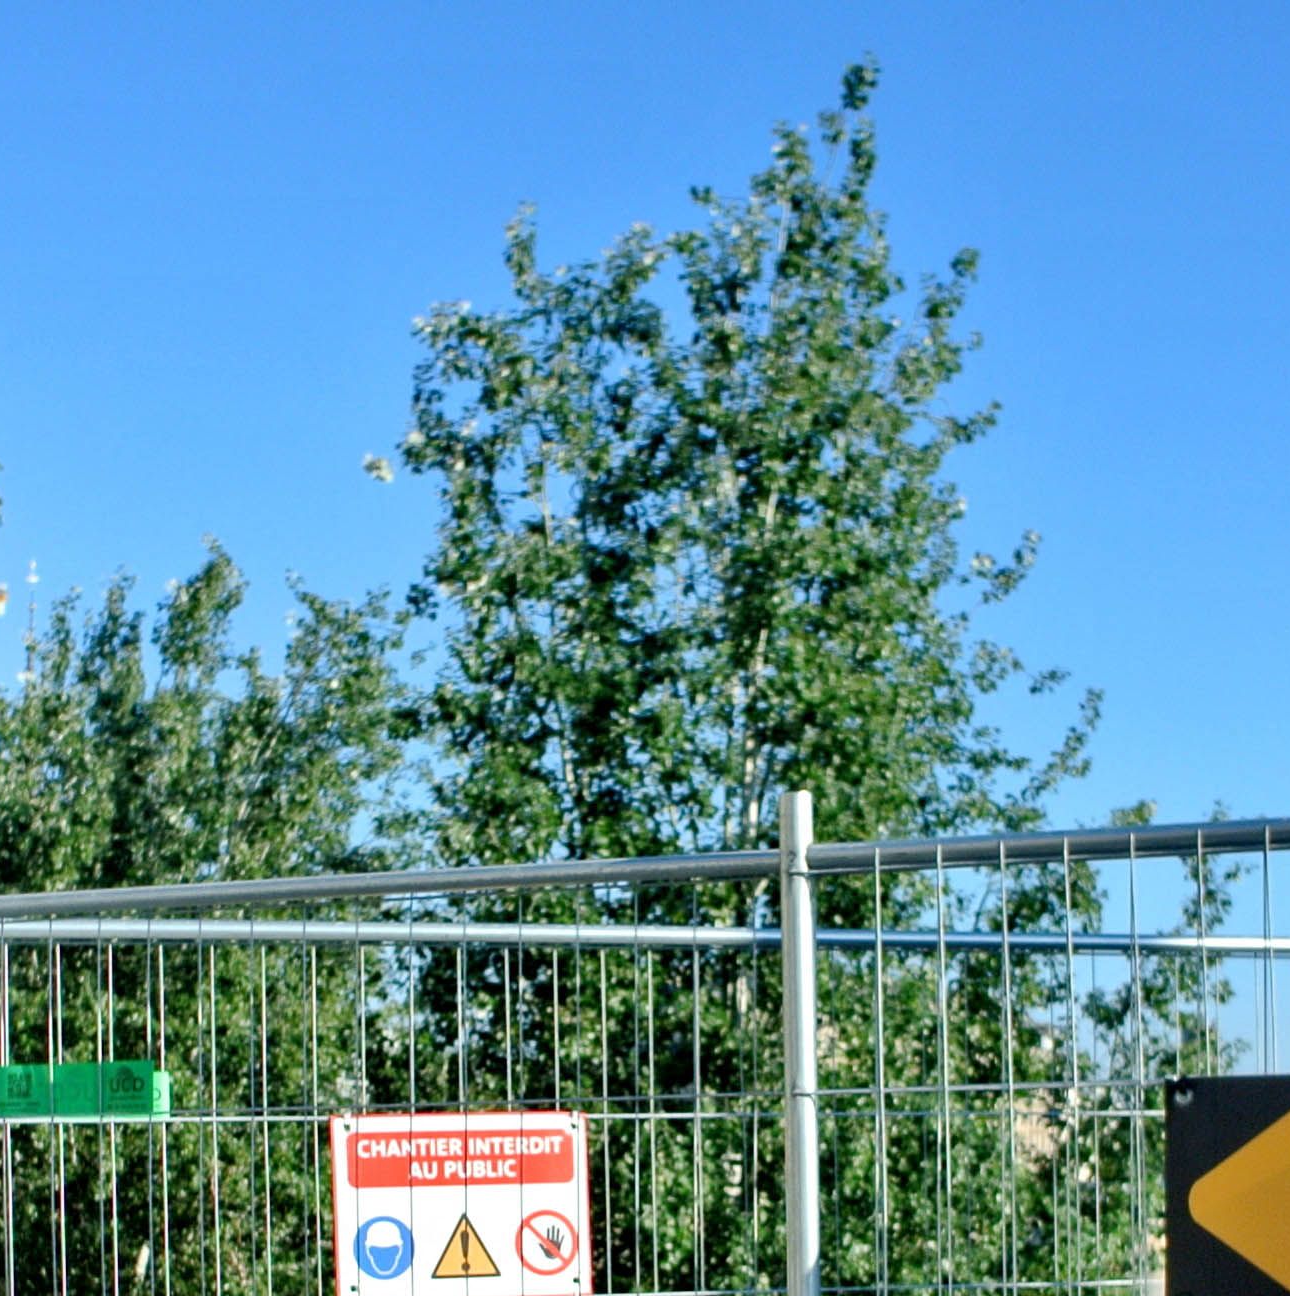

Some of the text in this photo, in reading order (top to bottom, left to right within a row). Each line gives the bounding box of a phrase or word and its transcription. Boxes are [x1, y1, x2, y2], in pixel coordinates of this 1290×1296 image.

[356, 1135, 564, 1159] CHANTIER INTERDIT
[410, 1159, 517, 1181] AU PUBLIC
